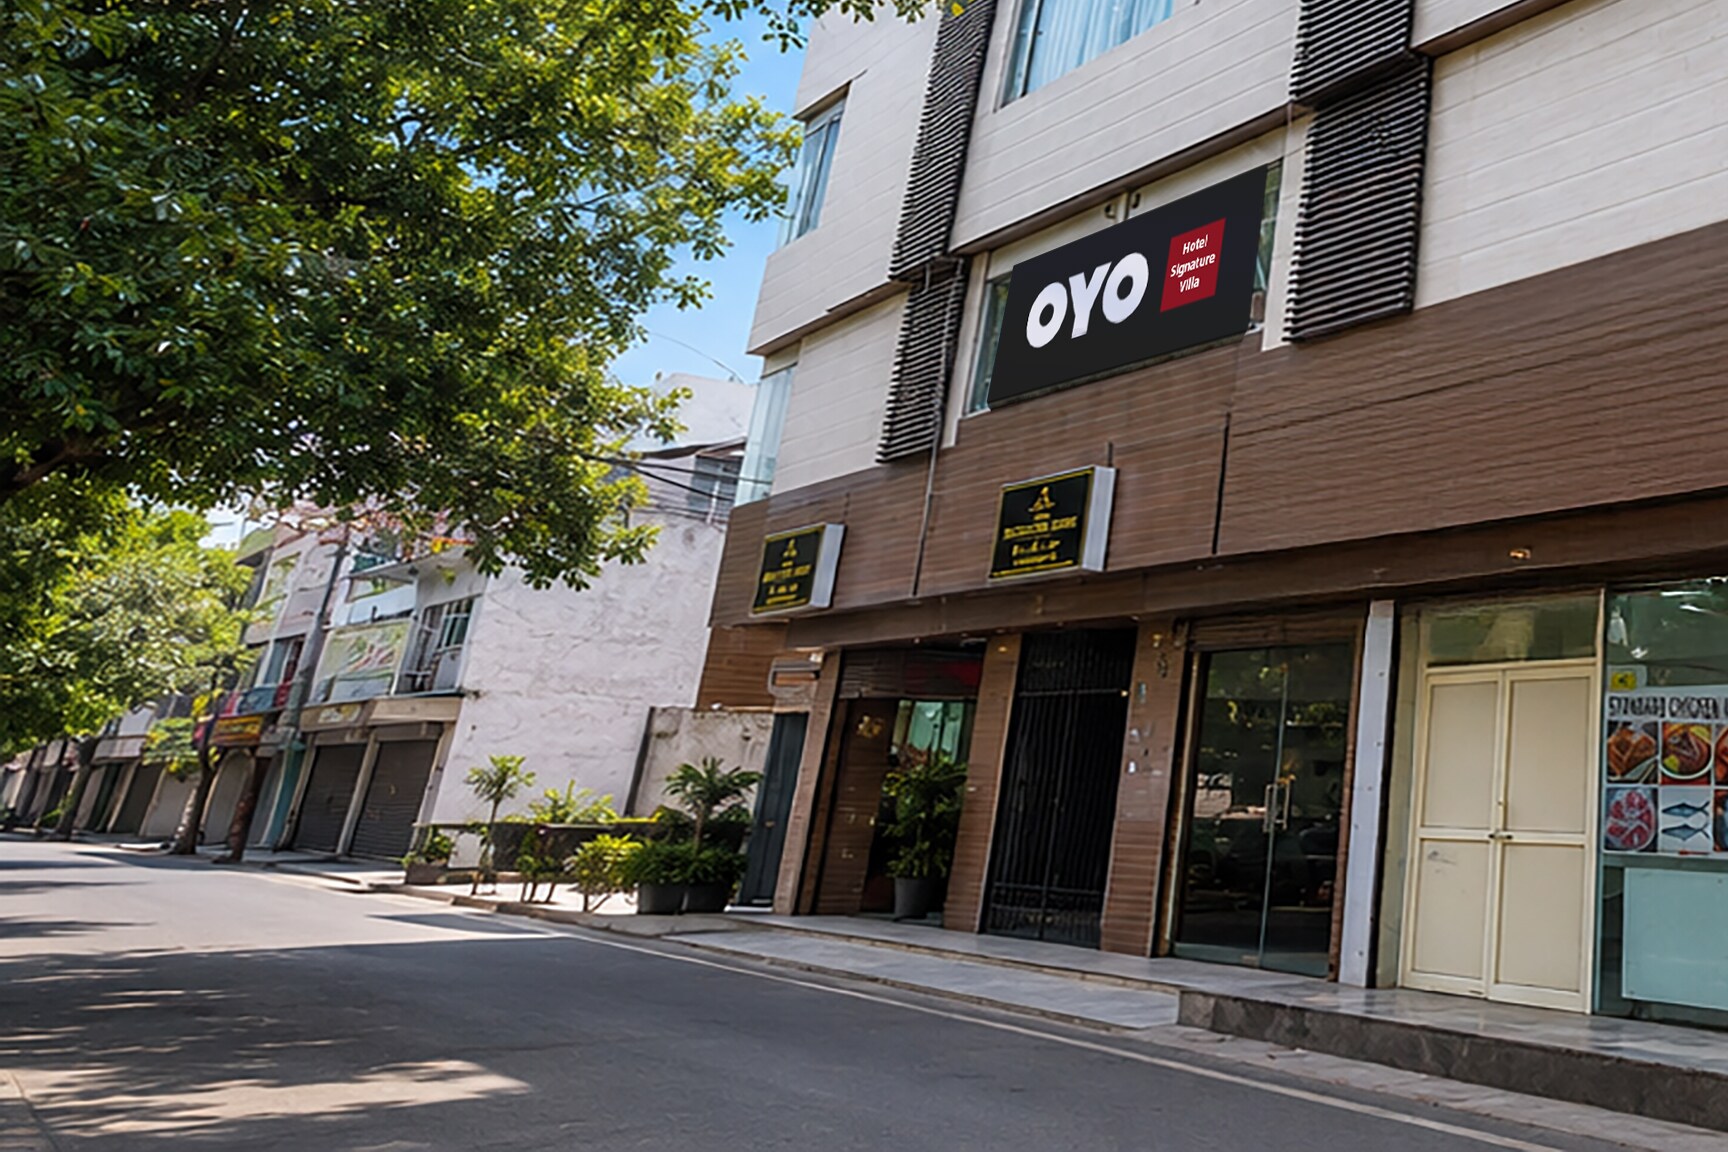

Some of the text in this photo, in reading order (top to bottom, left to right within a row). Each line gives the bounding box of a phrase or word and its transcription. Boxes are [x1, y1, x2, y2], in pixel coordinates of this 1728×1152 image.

[1182, 234, 1208, 255] Hotel
[1170, 252, 1216, 278] Signature
[1179, 277, 1200, 293] Villa
[1026, 252, 1149, 348] OYO
